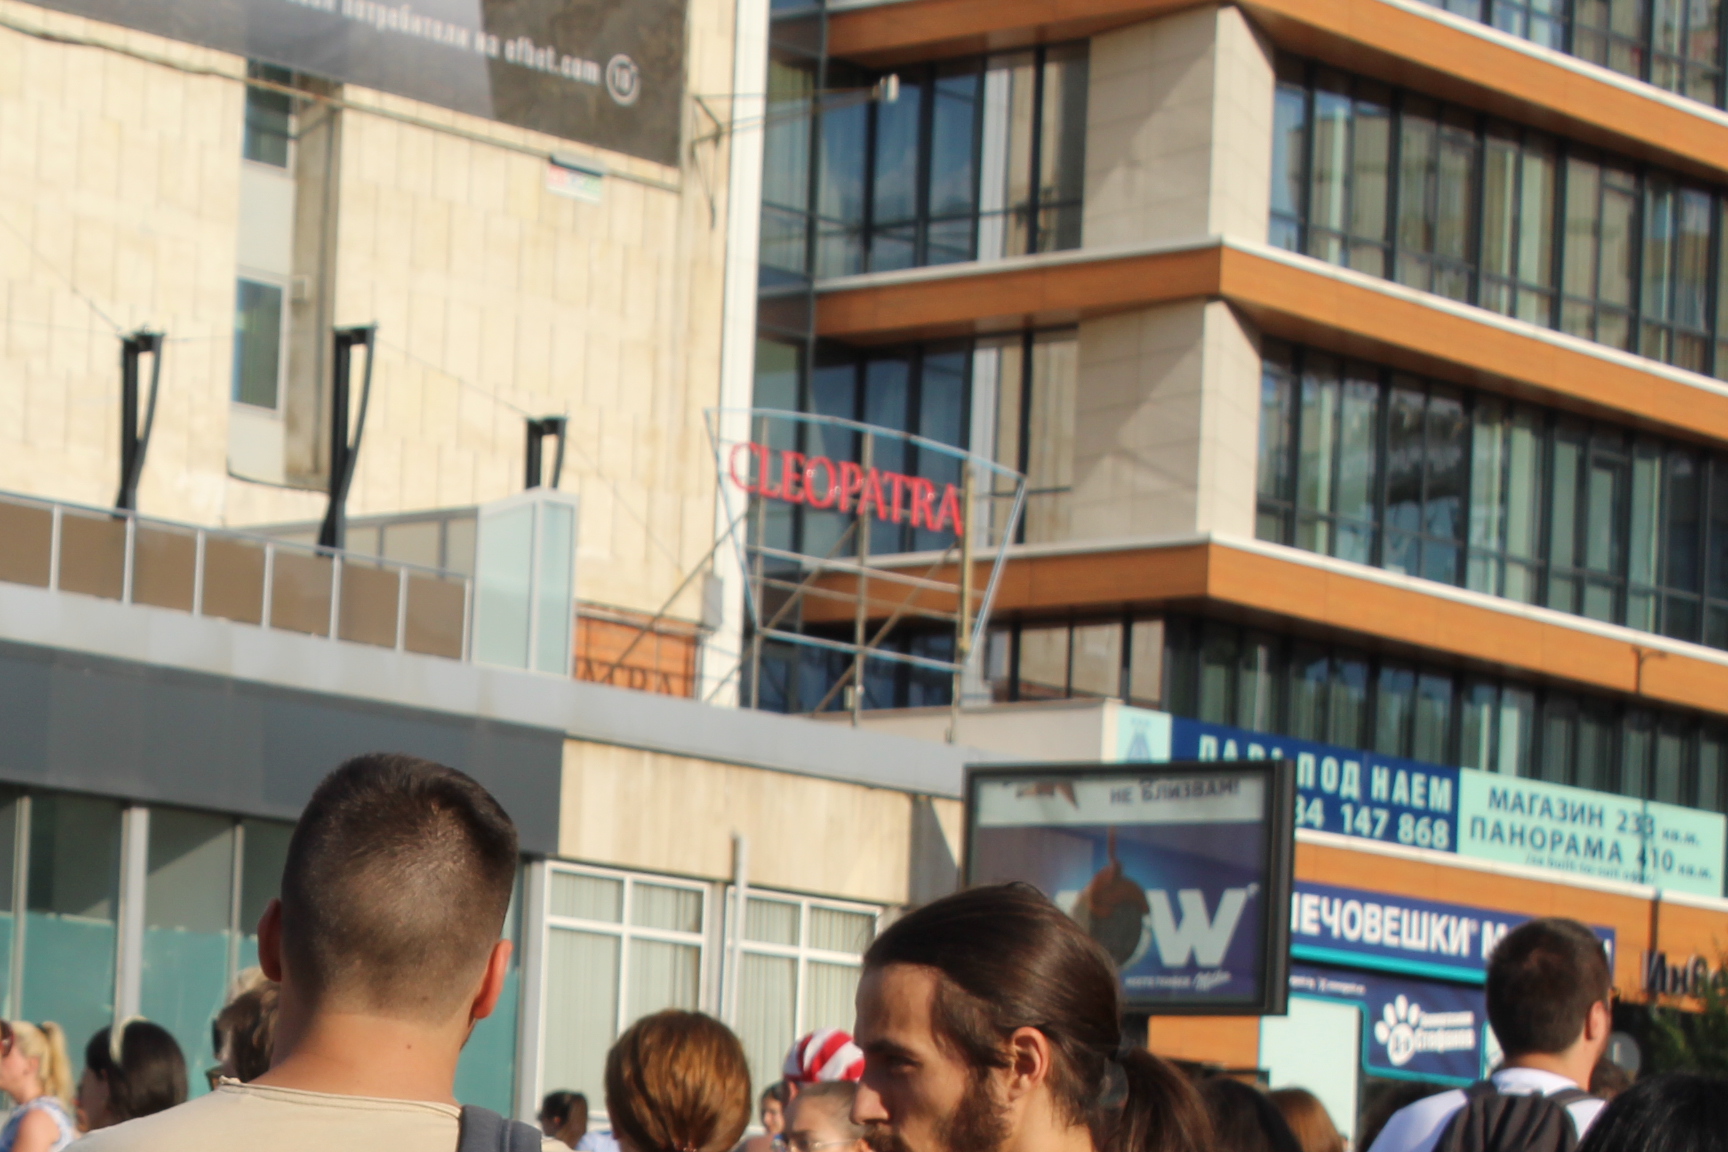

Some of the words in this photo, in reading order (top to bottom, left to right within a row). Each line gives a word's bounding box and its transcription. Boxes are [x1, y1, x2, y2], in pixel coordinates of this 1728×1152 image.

[729, 441, 965, 538] CLEOPATRA
[1296, 752, 1362, 801] ПОД
[1370, 764, 1453, 815] НАЕМ
[1488, 786, 1605, 828] МАГАЗИН
[1340, 802, 1390, 840] 147
[1397, 813, 1449, 851] 868
[1470, 816, 1623, 864] ПАНОРАМА
